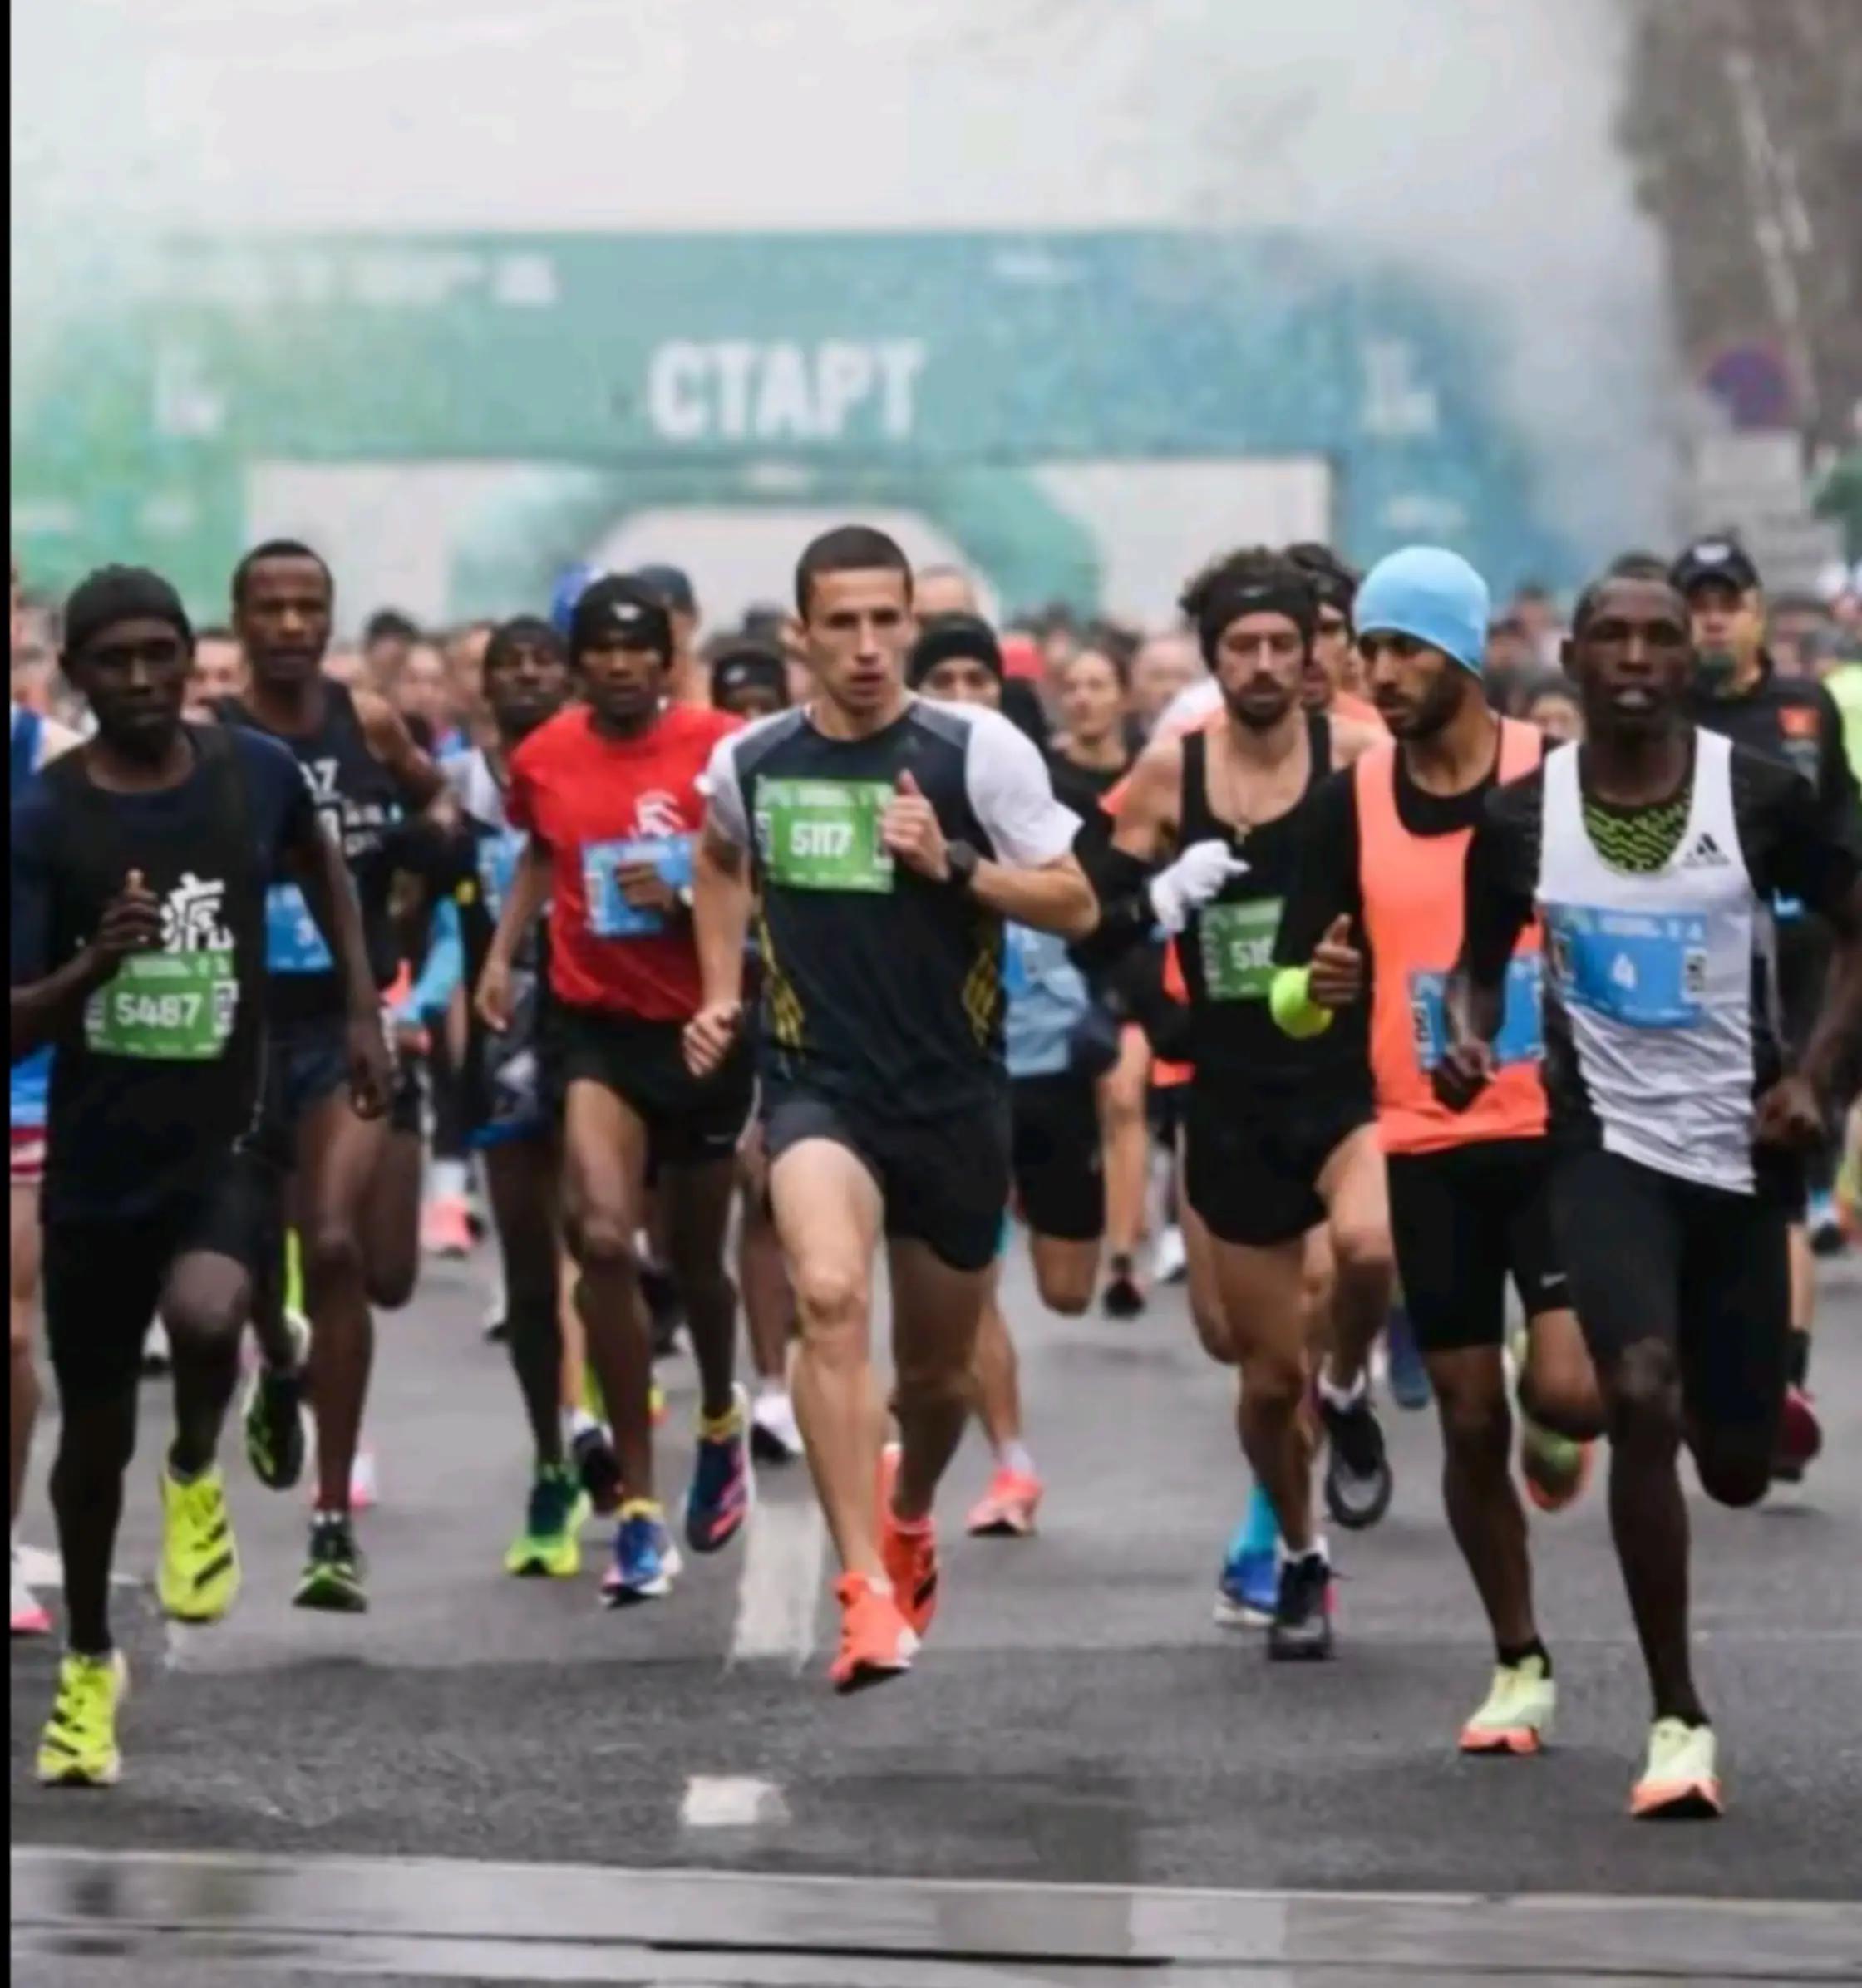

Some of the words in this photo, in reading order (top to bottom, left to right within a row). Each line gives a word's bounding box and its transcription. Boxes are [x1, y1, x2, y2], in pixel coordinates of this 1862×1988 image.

[648, 339, 926, 438] СТАРТ
[791, 820, 854, 857] 5117
[1611, 951, 1638, 991] 4
[116, 992, 202, 1028] 5487
